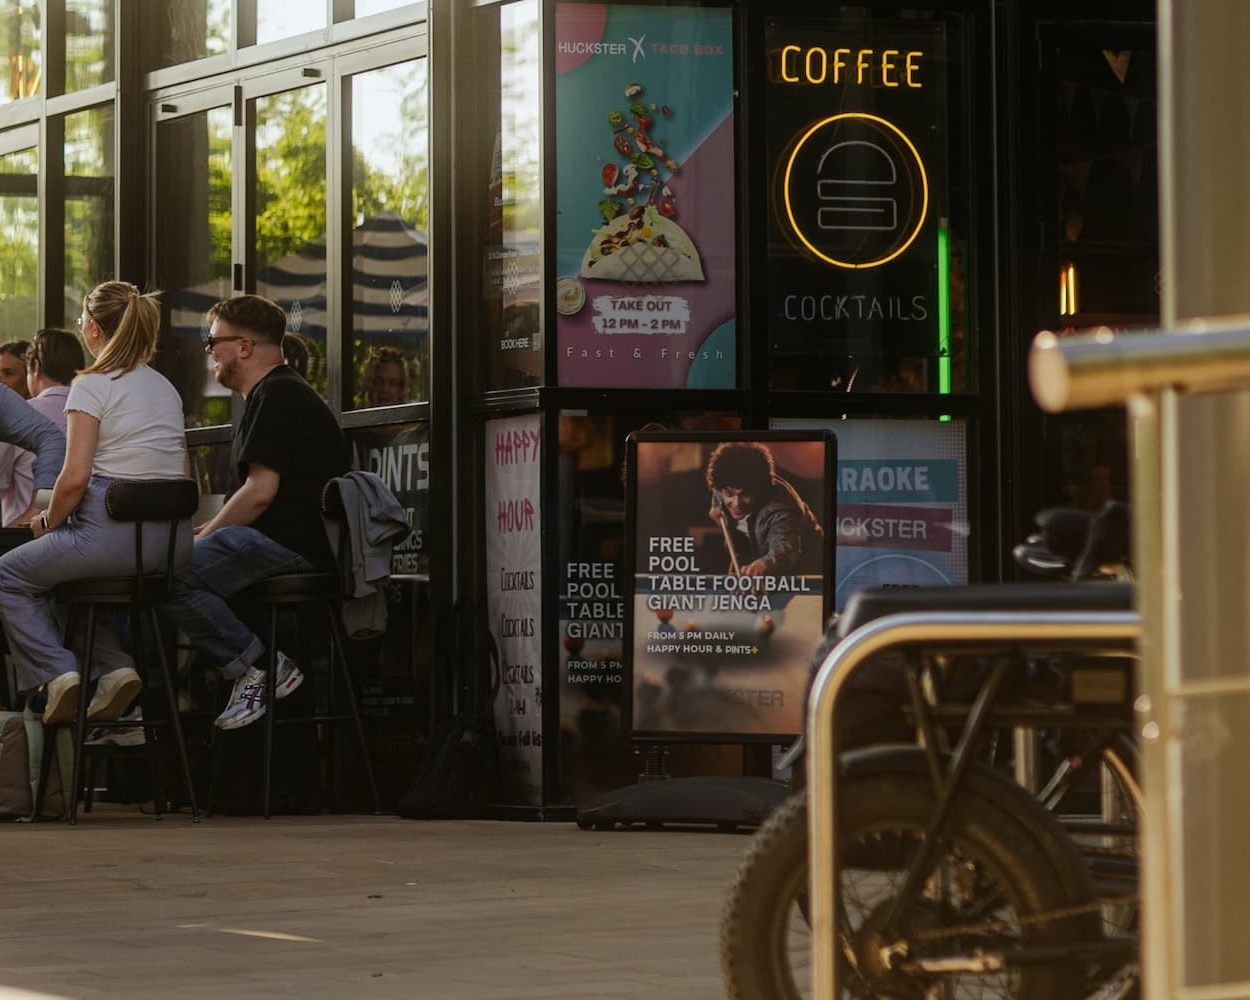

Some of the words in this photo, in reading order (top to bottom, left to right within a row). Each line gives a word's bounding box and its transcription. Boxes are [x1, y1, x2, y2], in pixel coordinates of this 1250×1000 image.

[558, 42, 627, 55] HUCKSTER
[651, 43, 689, 55] TACO
[694, 44, 724, 56] BOX
[781, 45, 924, 88] COFFEE
[611, 300, 644, 311] TAKE
[646, 300, 672, 311] OUT
[784, 295, 928, 321] COCKTAILS
[602, 318, 617, 329] 12
[619, 319, 639, 329] PM
[650, 319, 659, 329] 2
[662, 319, 681, 329] PM
[566, 346, 615, 358] Fast
[633, 348, 642, 359] &
[661, 348, 723, 359] Fresh
[495, 429, 541, 465] HAPPY
[837, 466, 930, 492] RAOKE
[497, 498, 535, 534] HOUR
[837, 517, 927, 540] CKSTER
[649, 536, 695, 553] FREE
[566, 563, 615, 578] FREE
[649, 556, 700, 572] POOL
[566, 582, 621, 599] POOL
[648, 575, 706, 591] TABLE
[713, 575, 811, 592] FOOTBALL
[566, 602, 624, 618] TABLE
[648, 594, 704, 610] GIANT
[711, 594, 772, 611] JENGA
[647, 631, 676, 640] FROM
[679, 631, 685, 640] 5
[687, 631, 702, 640] PM
[705, 631, 735, 640] DAILY
[647, 645, 681, 654] HAPPY
[683, 645, 713, 654] HOUR
[715, 645, 723, 654] &
[567, 661, 598, 670] FROM
[600, 661, 607, 670] 5
[567, 674, 603, 683] HAPPY
[606, 674, 622, 683] HO
